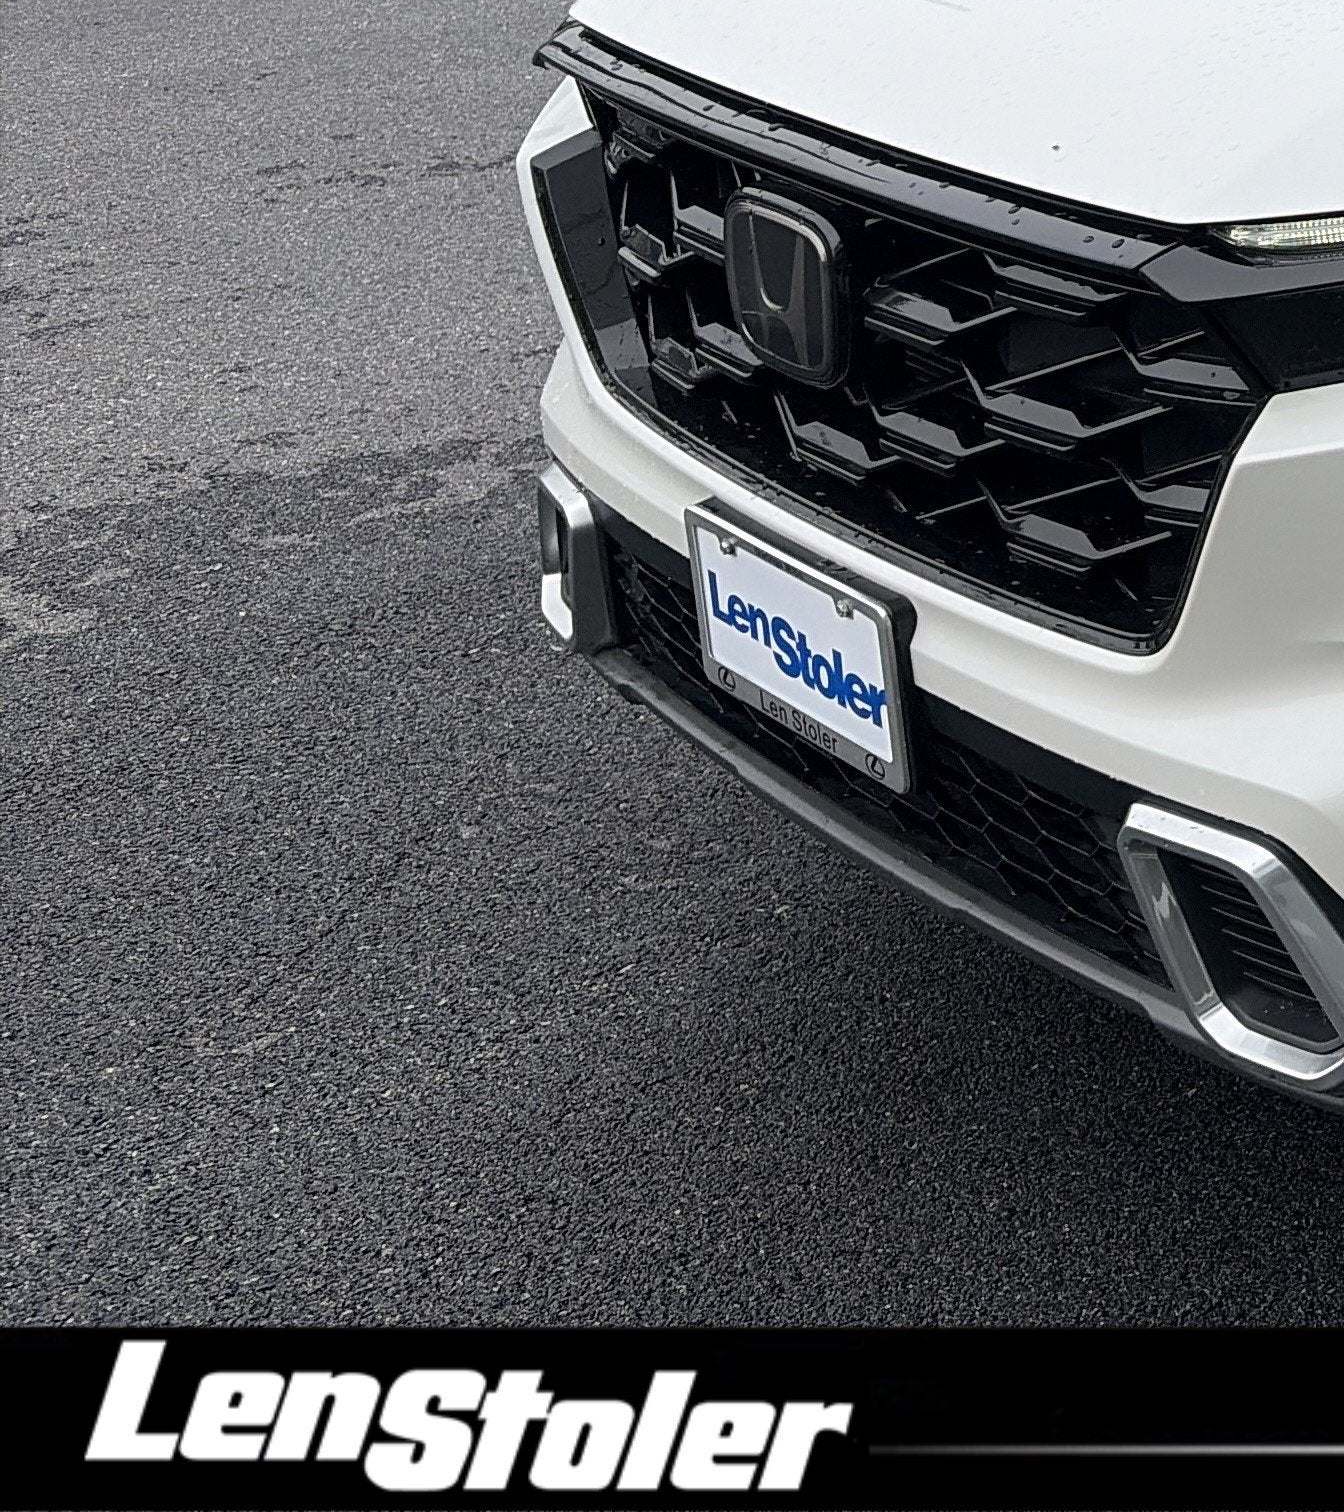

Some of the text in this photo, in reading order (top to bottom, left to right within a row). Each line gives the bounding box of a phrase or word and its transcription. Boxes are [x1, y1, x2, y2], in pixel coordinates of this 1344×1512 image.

[708, 569, 887, 728] LenStoler
[760, 690, 838, 753] Len Stoler
